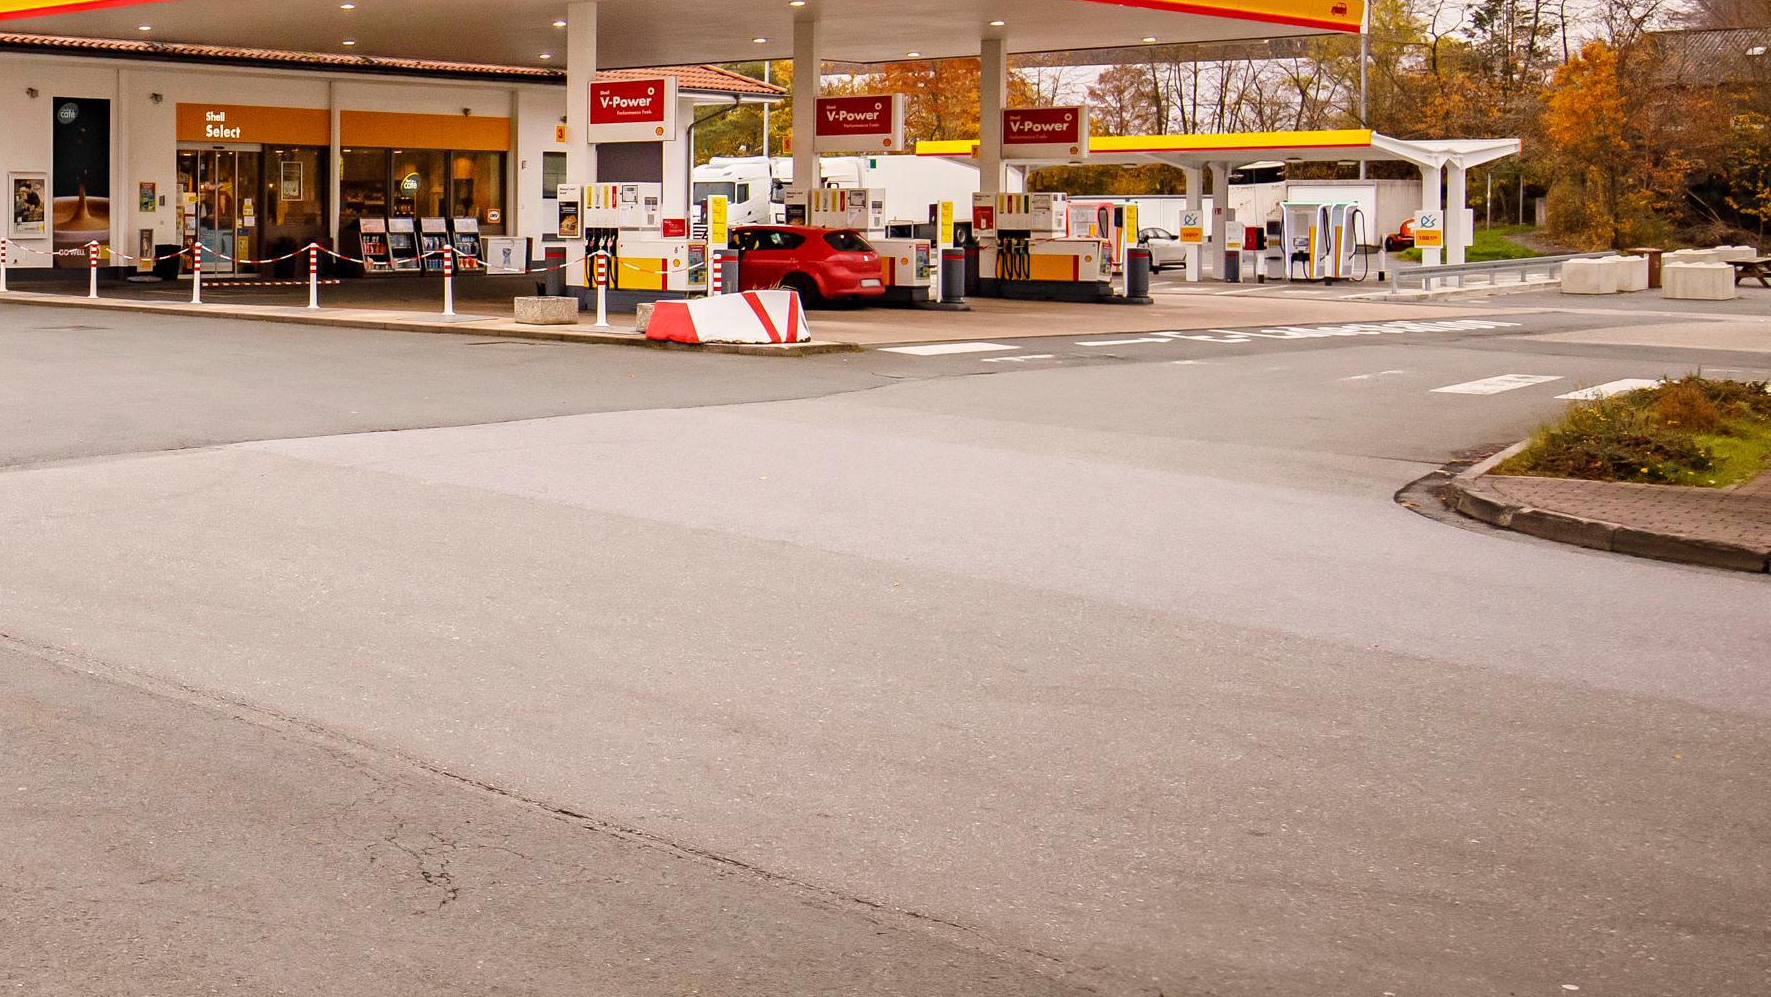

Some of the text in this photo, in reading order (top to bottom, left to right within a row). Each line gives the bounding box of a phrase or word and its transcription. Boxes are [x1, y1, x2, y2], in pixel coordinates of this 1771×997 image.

[600, 96, 652, 108] V-Power
[205, 111, 225, 122] Shell
[826, 110, 880, 122] V-Power
[205, 124, 241, 139] Select
[1009, 120, 1070, 133] V-Power
[558, 128, 563, 138] 3
